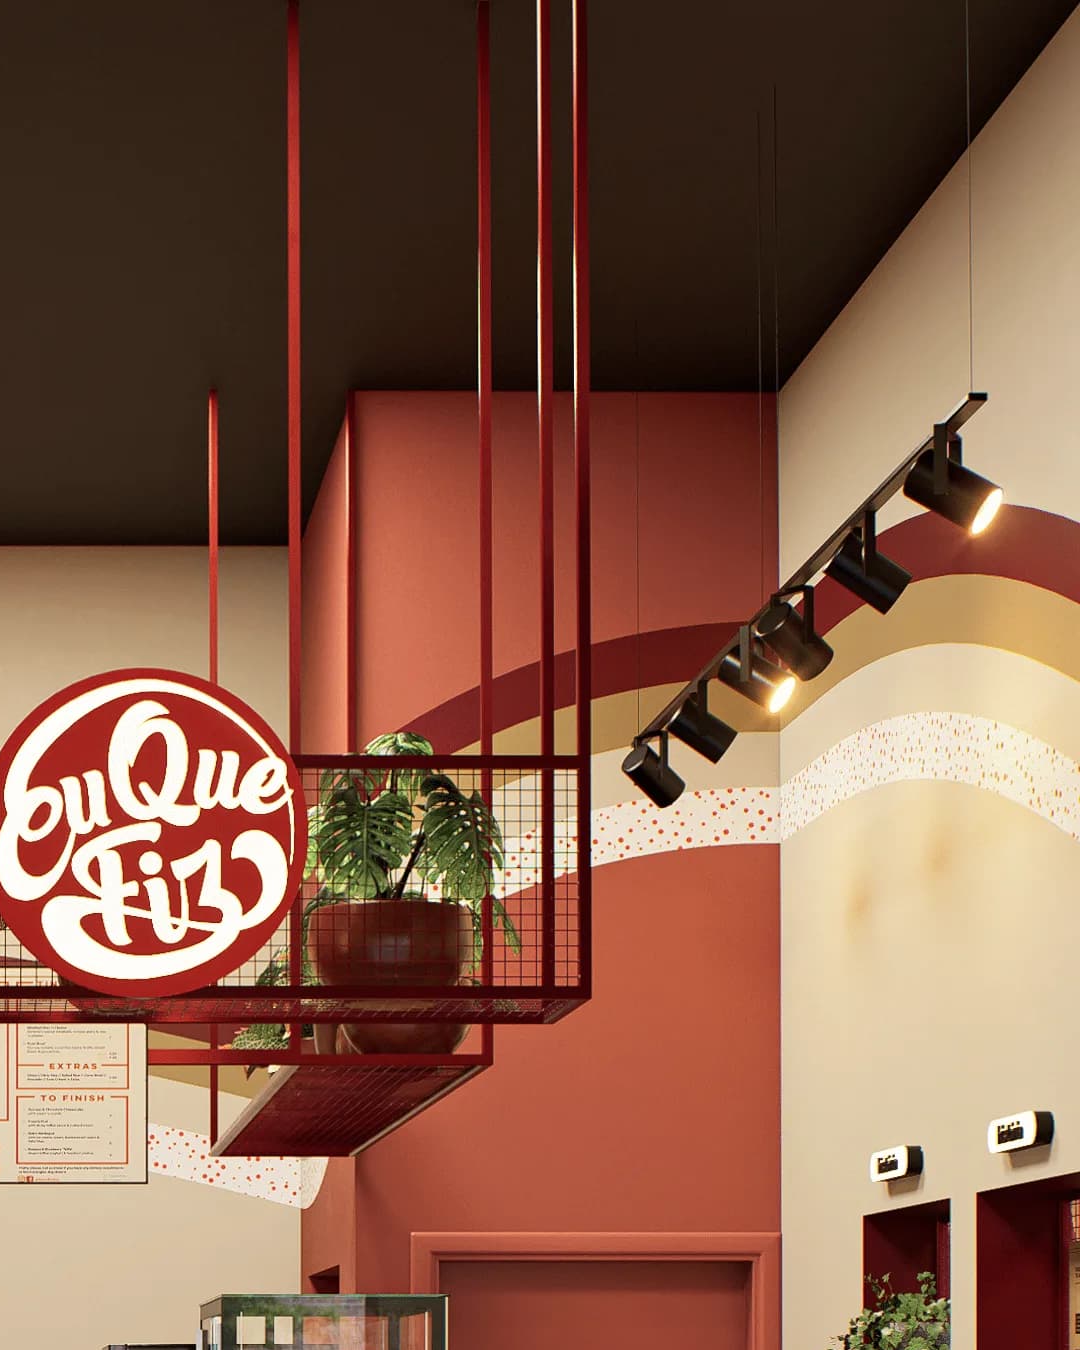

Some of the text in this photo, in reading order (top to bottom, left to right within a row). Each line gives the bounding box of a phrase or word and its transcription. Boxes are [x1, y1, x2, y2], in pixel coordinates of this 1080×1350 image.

[108, 700, 293, 826] Que
[41, 822, 288, 965] Fiz
[49, 1063, 98, 1071] EXTRAS
